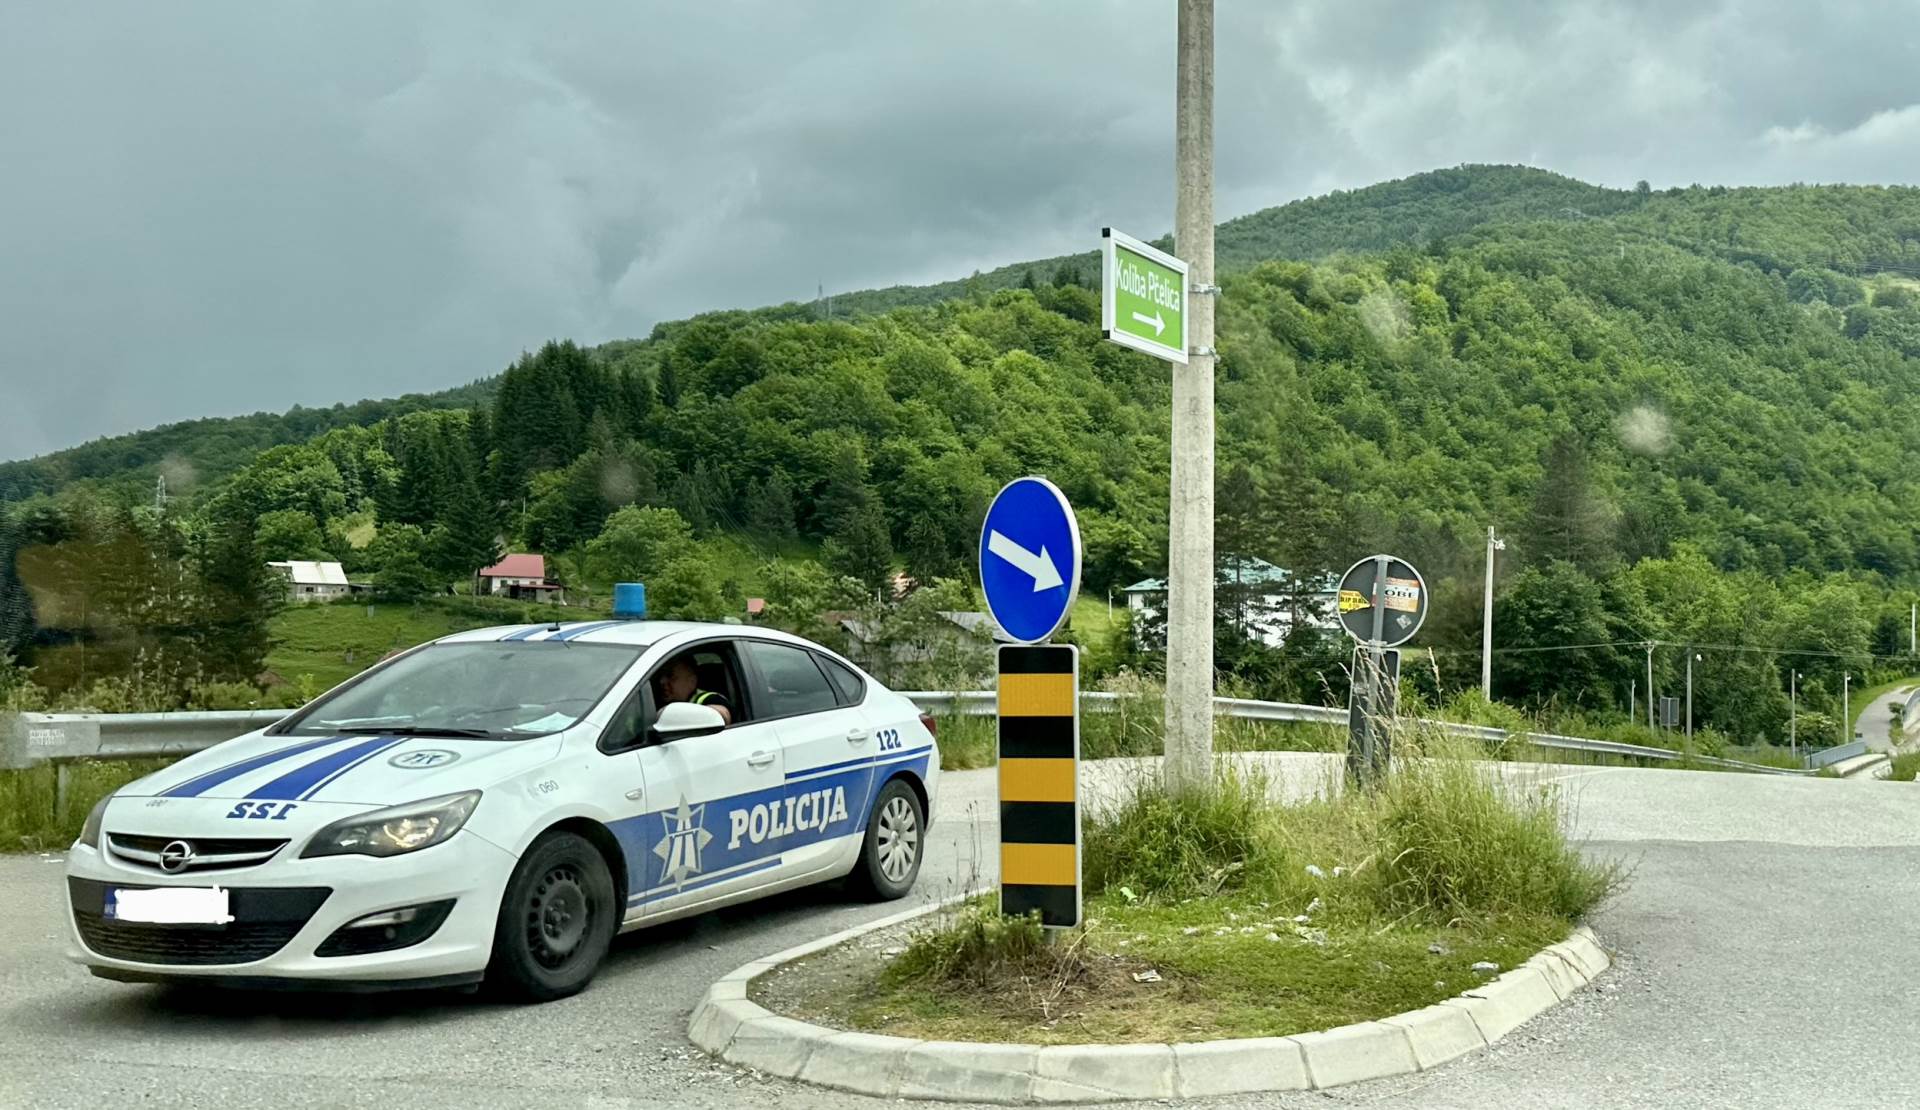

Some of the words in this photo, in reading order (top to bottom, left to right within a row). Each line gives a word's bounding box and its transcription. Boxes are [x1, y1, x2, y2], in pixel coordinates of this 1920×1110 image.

[1115, 257, 1146, 298] Koliba
[1148, 271, 1180, 311] Pčelica
[876, 728, 902, 751] 122
[538, 780, 559, 793] 060
[727, 785, 848, 850] POLICIJA
